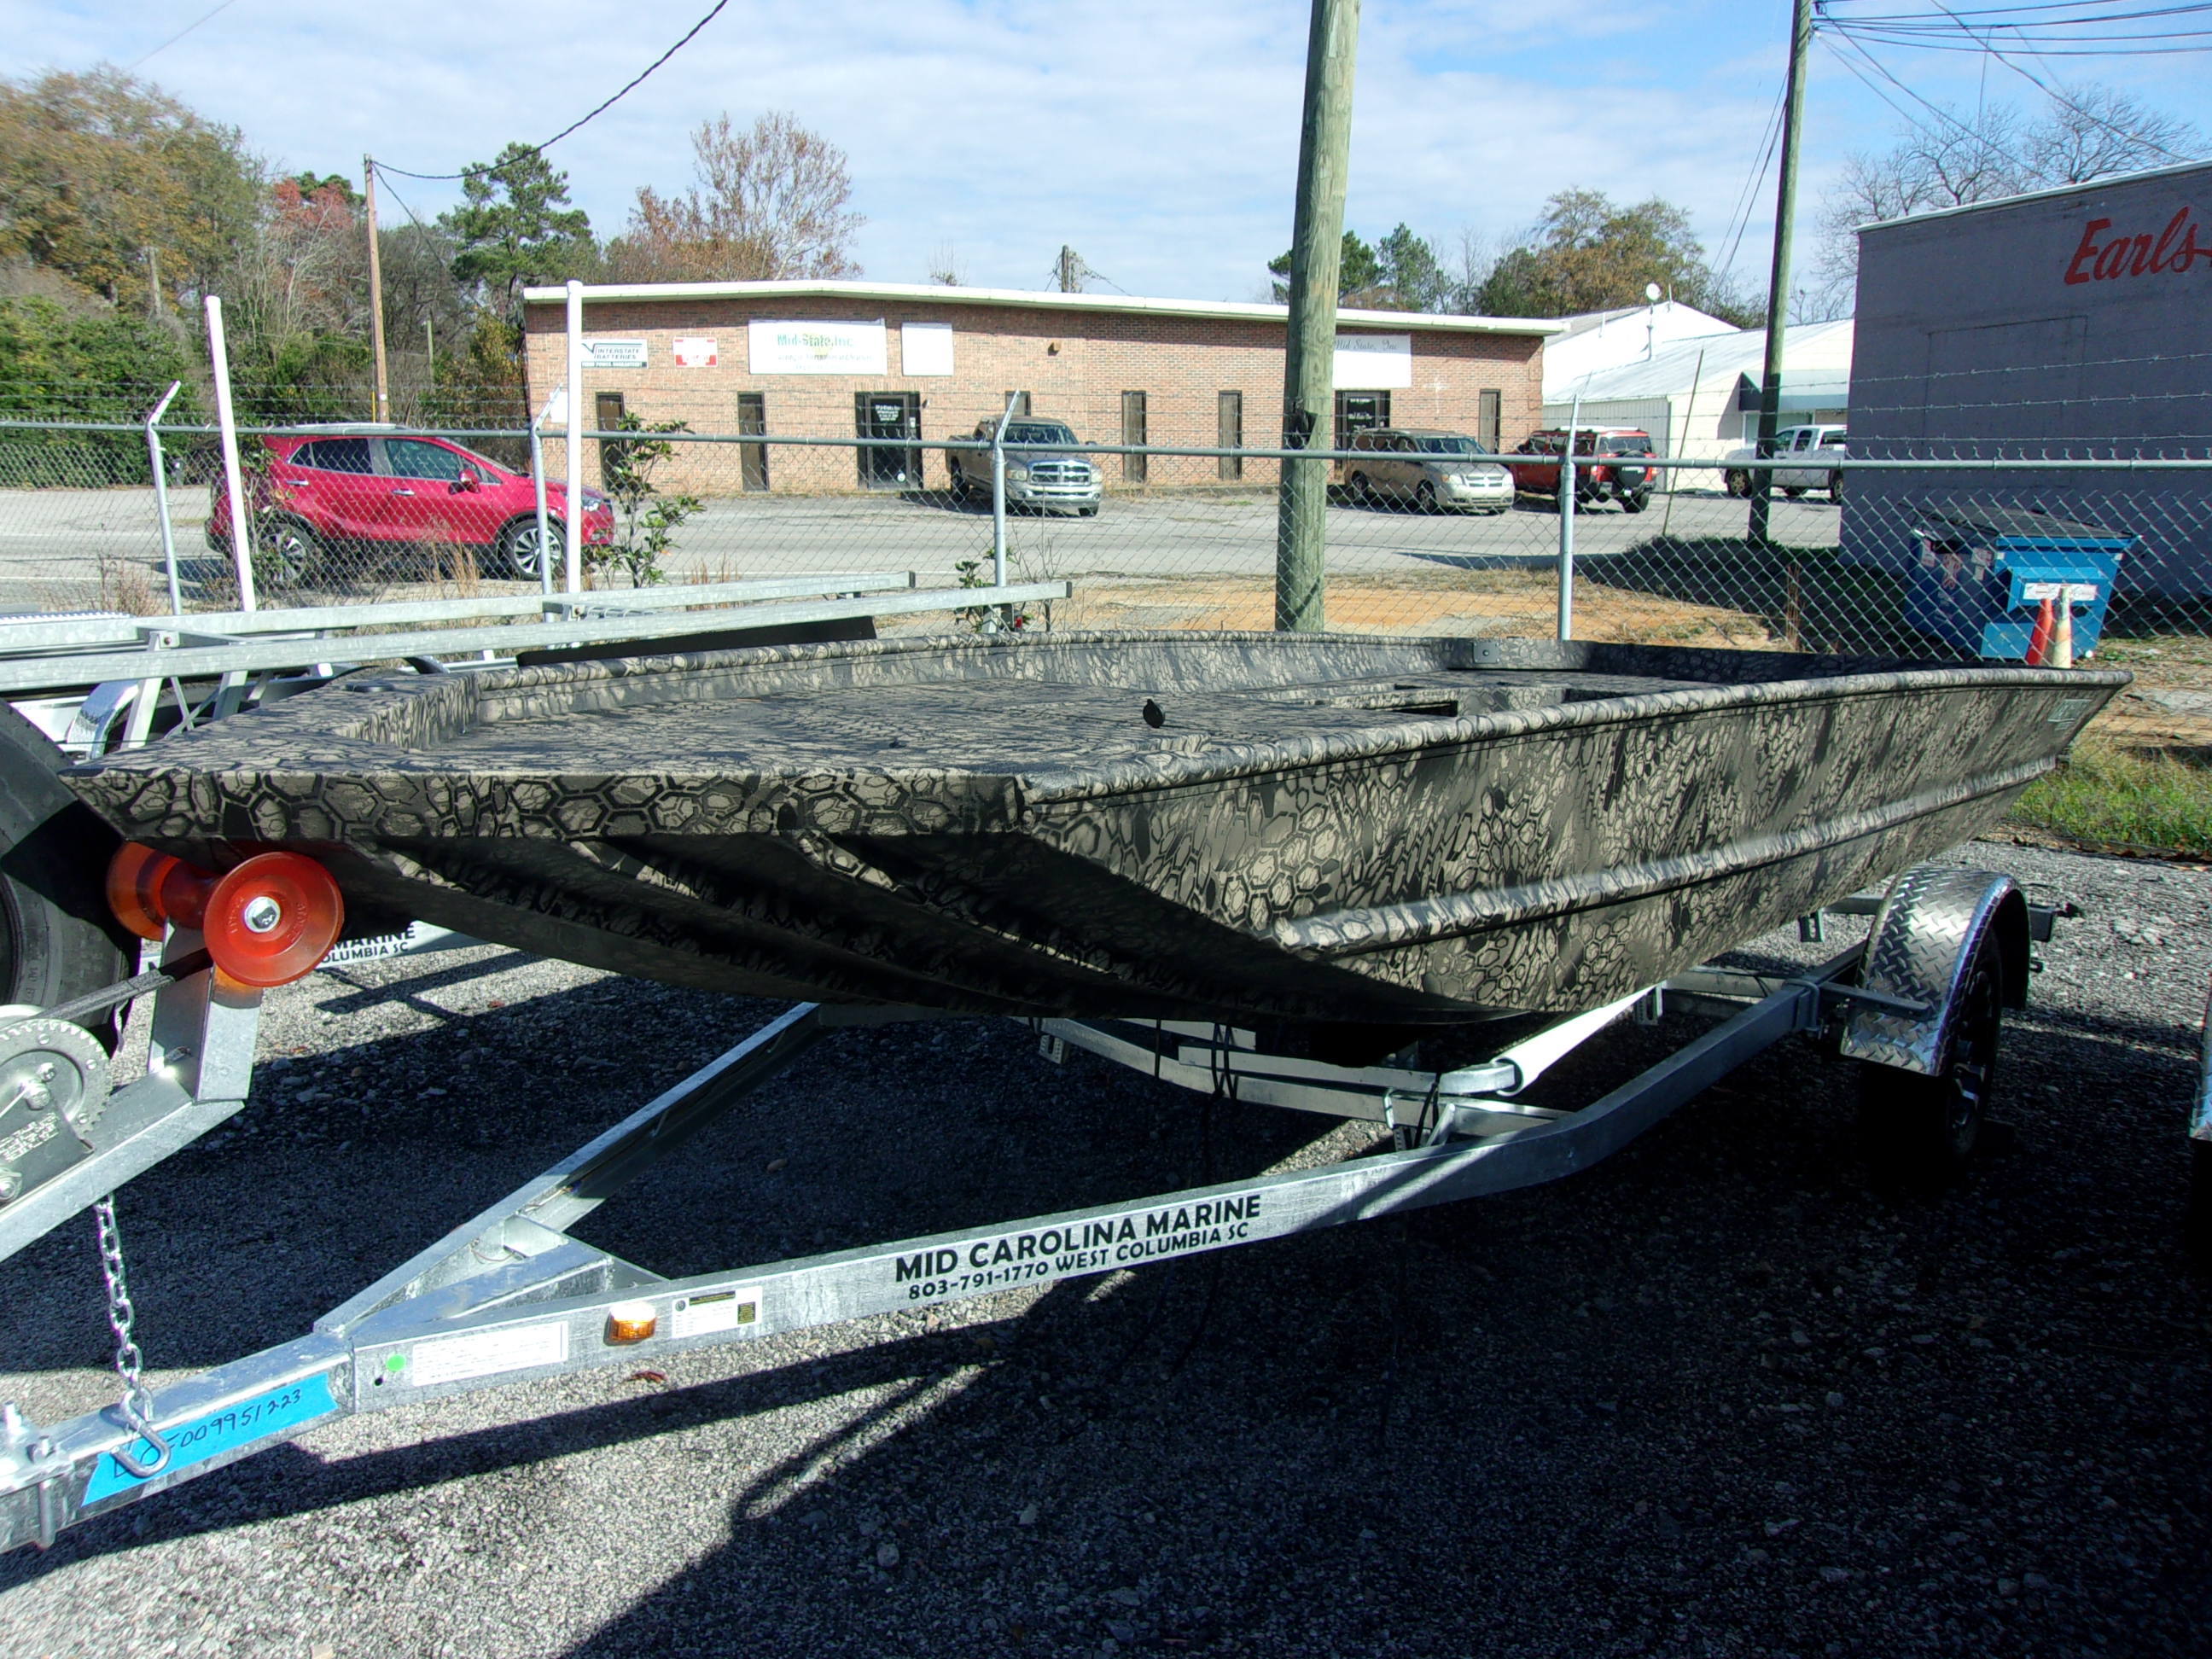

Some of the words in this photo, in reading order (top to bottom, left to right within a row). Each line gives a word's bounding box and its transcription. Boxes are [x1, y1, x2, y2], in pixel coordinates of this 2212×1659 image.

[2064, 206, 2212, 285] Earls
[321, 944, 389, 963] OLUMBIA
[393, 941, 409, 953] SC
[896, 1249, 958, 1282] MID
[969, 1218, 1137, 1268] CAROLINA
[1146, 1195, 1260, 1237] MARINE
[909, 1261, 1049, 1300] 803-791-1770
[1056, 1249, 1109, 1272] WEST
[1116, 1228, 1221, 1260] COLUMBIA
[1228, 1222, 1249, 1240] SC
